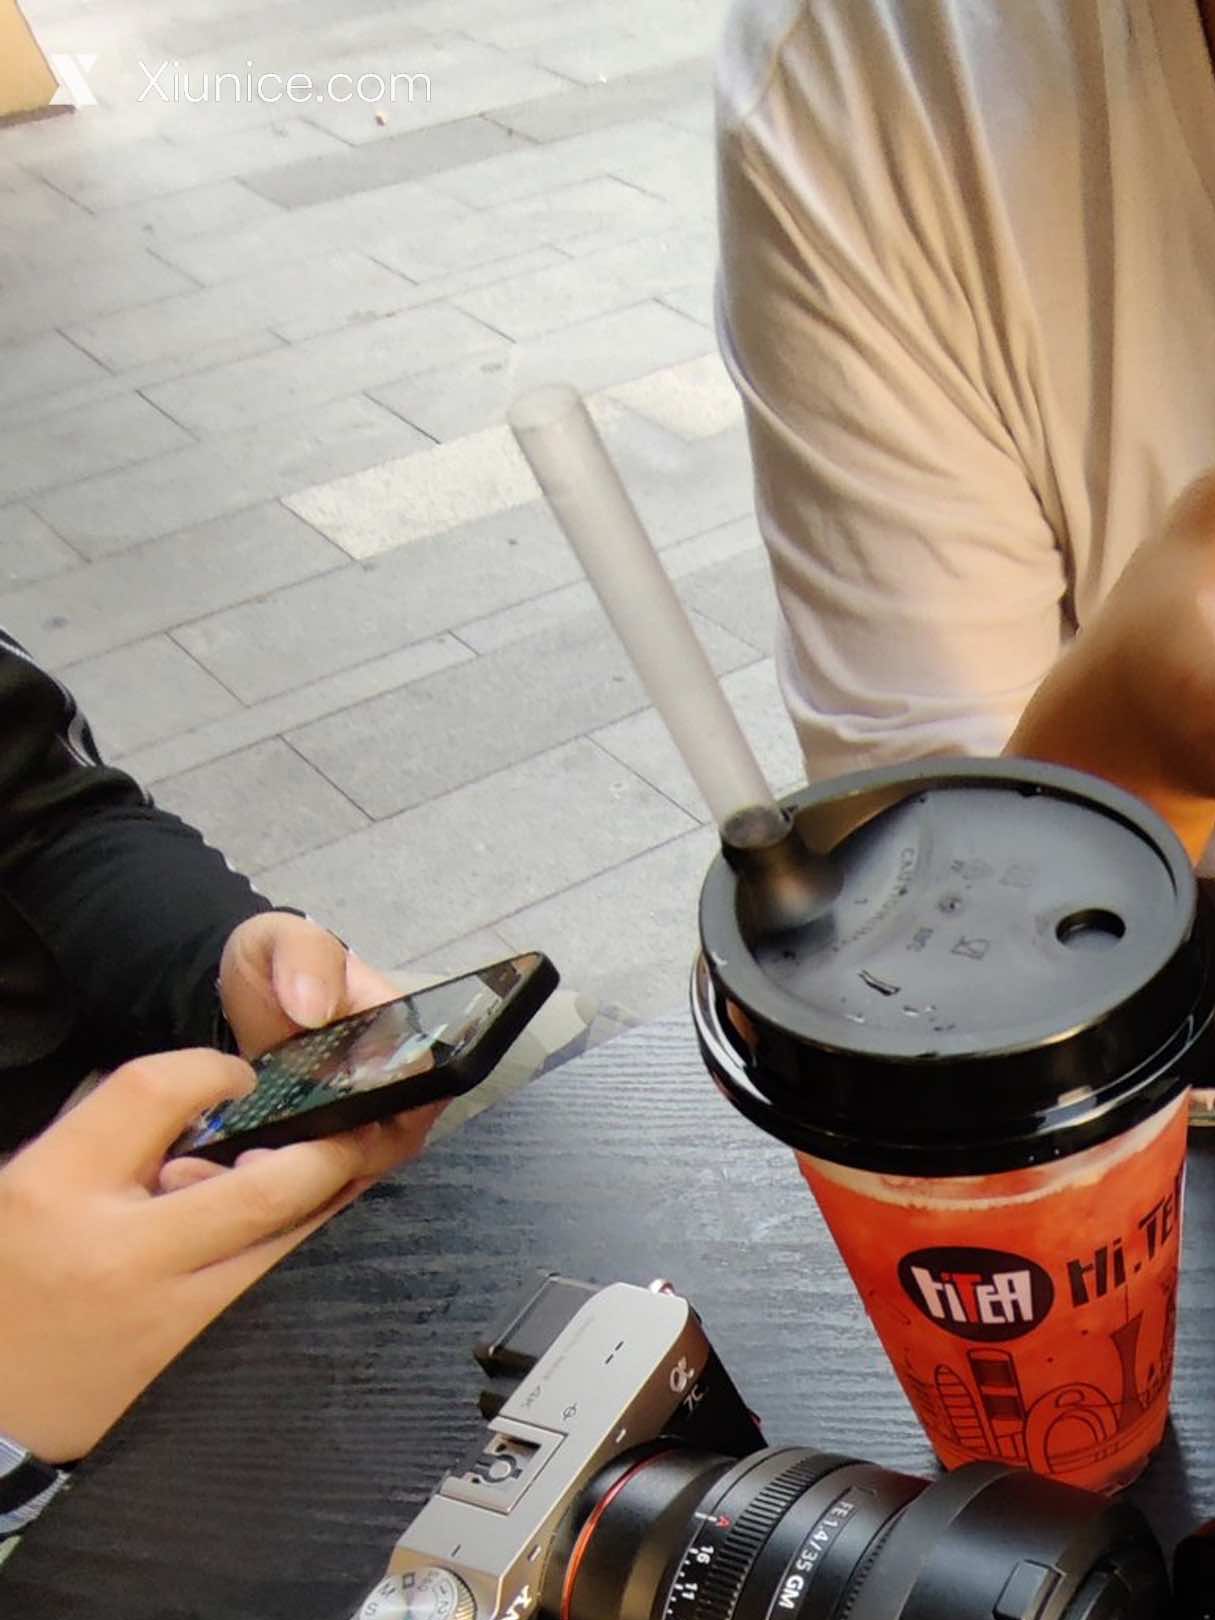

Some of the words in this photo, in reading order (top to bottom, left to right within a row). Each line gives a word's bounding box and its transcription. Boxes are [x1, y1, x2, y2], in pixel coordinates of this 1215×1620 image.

[831, 1501, 855, 1518] FE
[696, 1545, 715, 1564] 16
[795, 1519, 839, 1573] 1.4/35
[682, 1582, 699, 1601] 11
[778, 1574, 804, 1610] GM
